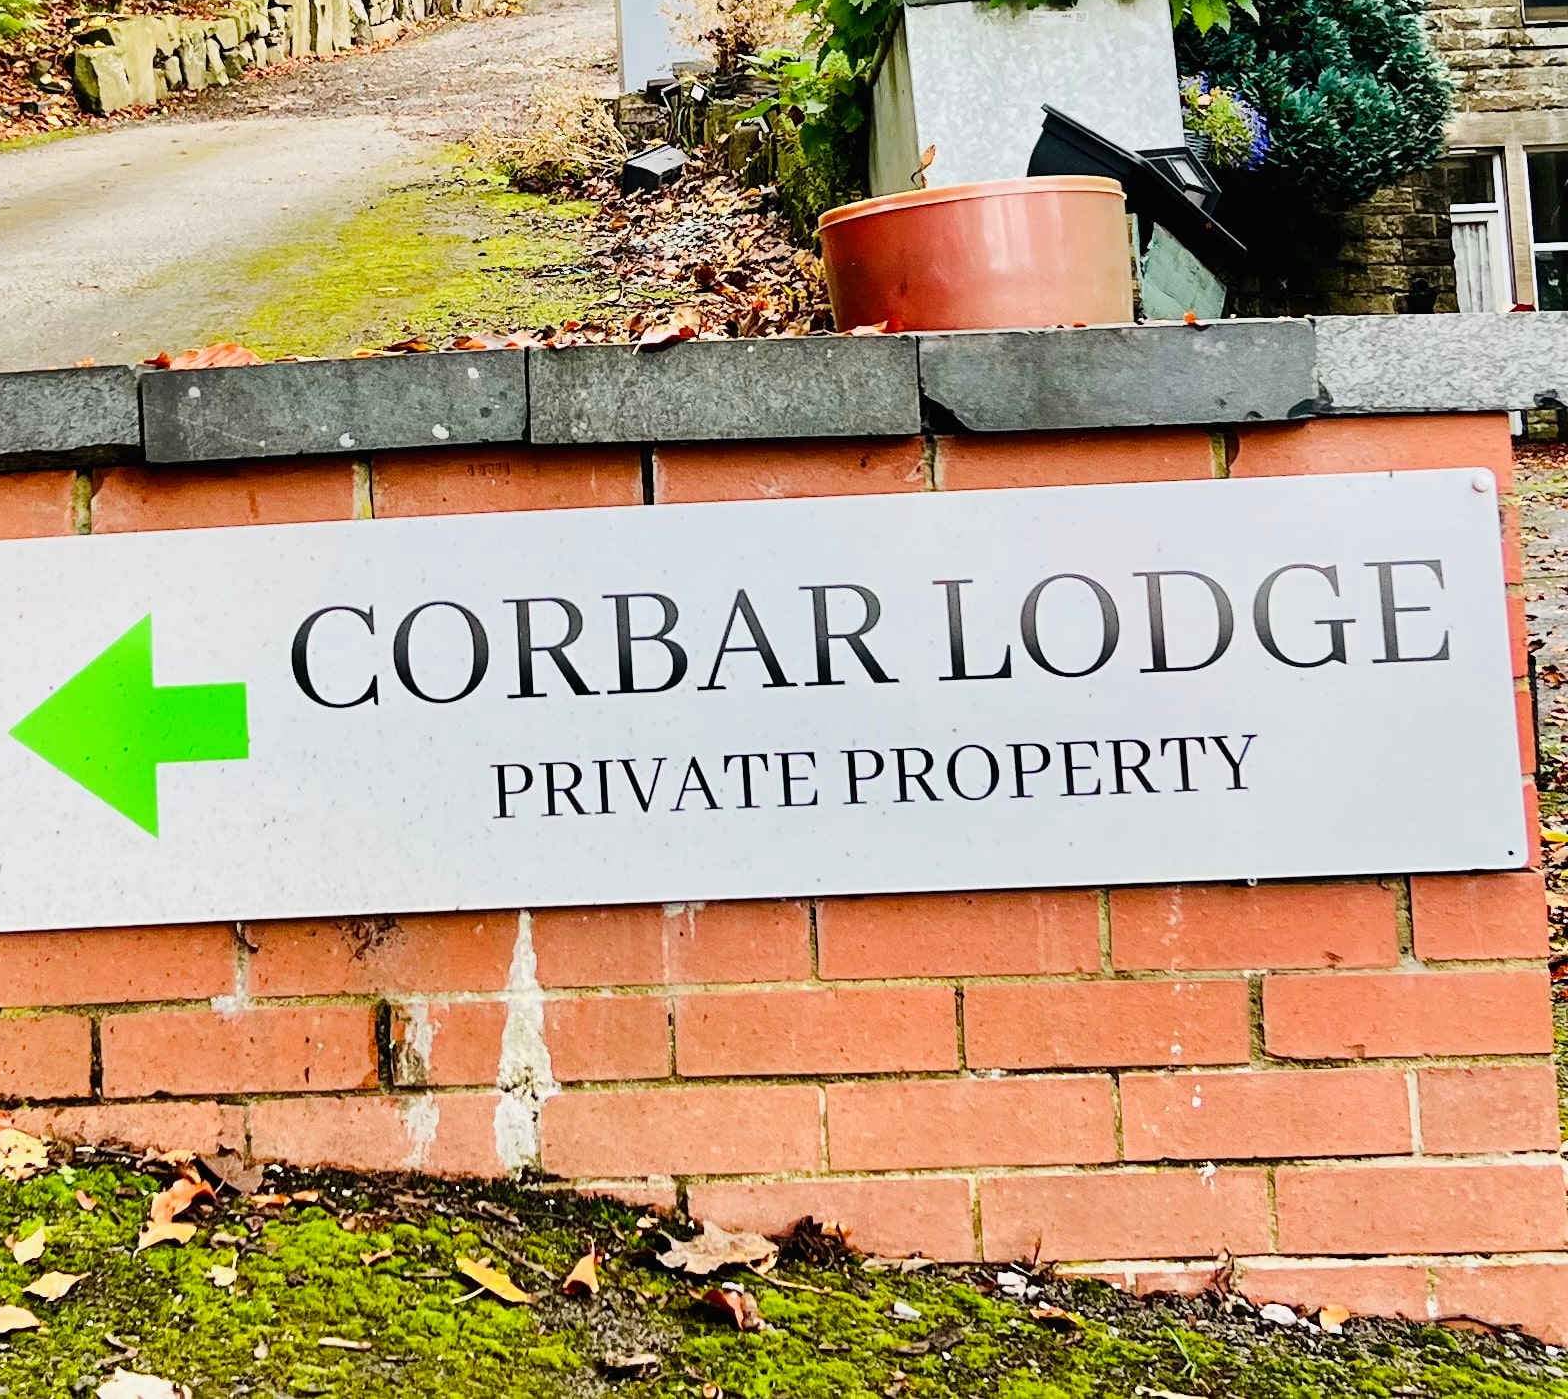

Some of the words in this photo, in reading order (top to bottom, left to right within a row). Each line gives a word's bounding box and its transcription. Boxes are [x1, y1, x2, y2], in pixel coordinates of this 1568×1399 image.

[292, 586, 899, 708] CORBAR
[933, 560, 1450, 682] LODGE
[491, 744, 818, 819] PRIVATE
[840, 735, 1258, 805] PROPERTY
